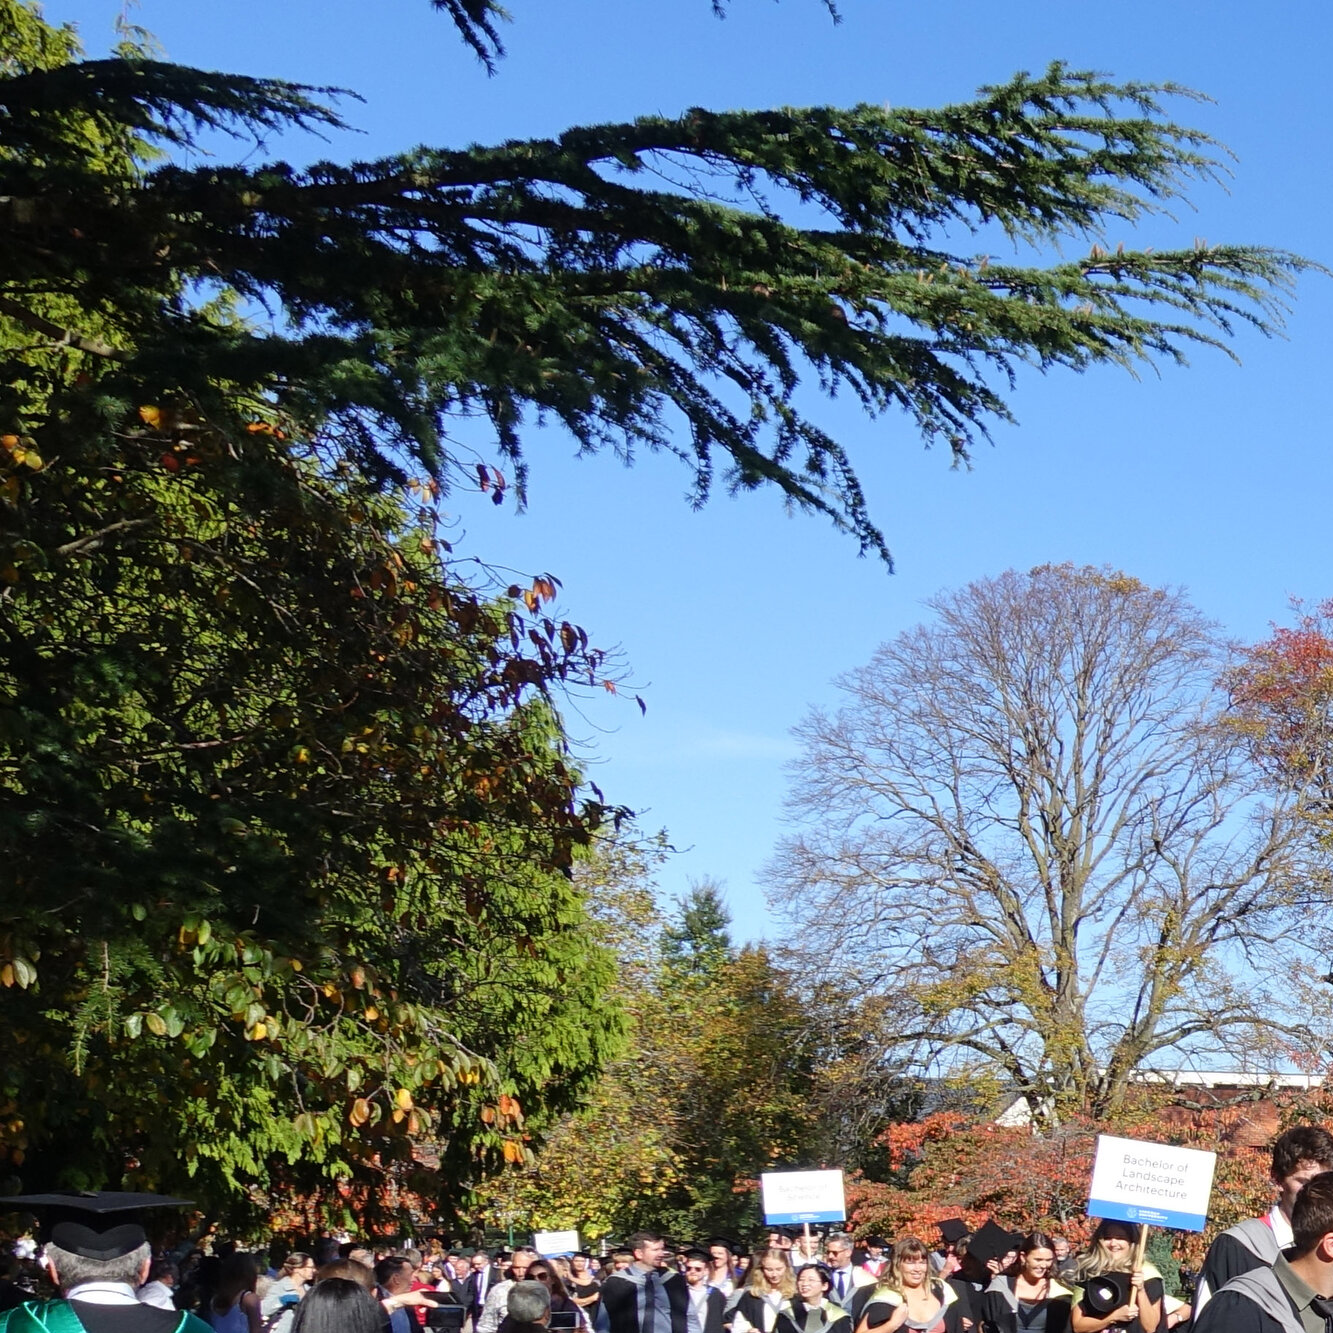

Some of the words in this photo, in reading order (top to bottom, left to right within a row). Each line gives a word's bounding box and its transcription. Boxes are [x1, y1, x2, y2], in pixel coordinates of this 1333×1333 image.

[1123, 1154, 1174, 1170] Bachelor
[1177, 1163, 1189, 1173] of
[1122, 1167, 1185, 1187] Landscape
[1115, 1180, 1188, 1199] Architecture
